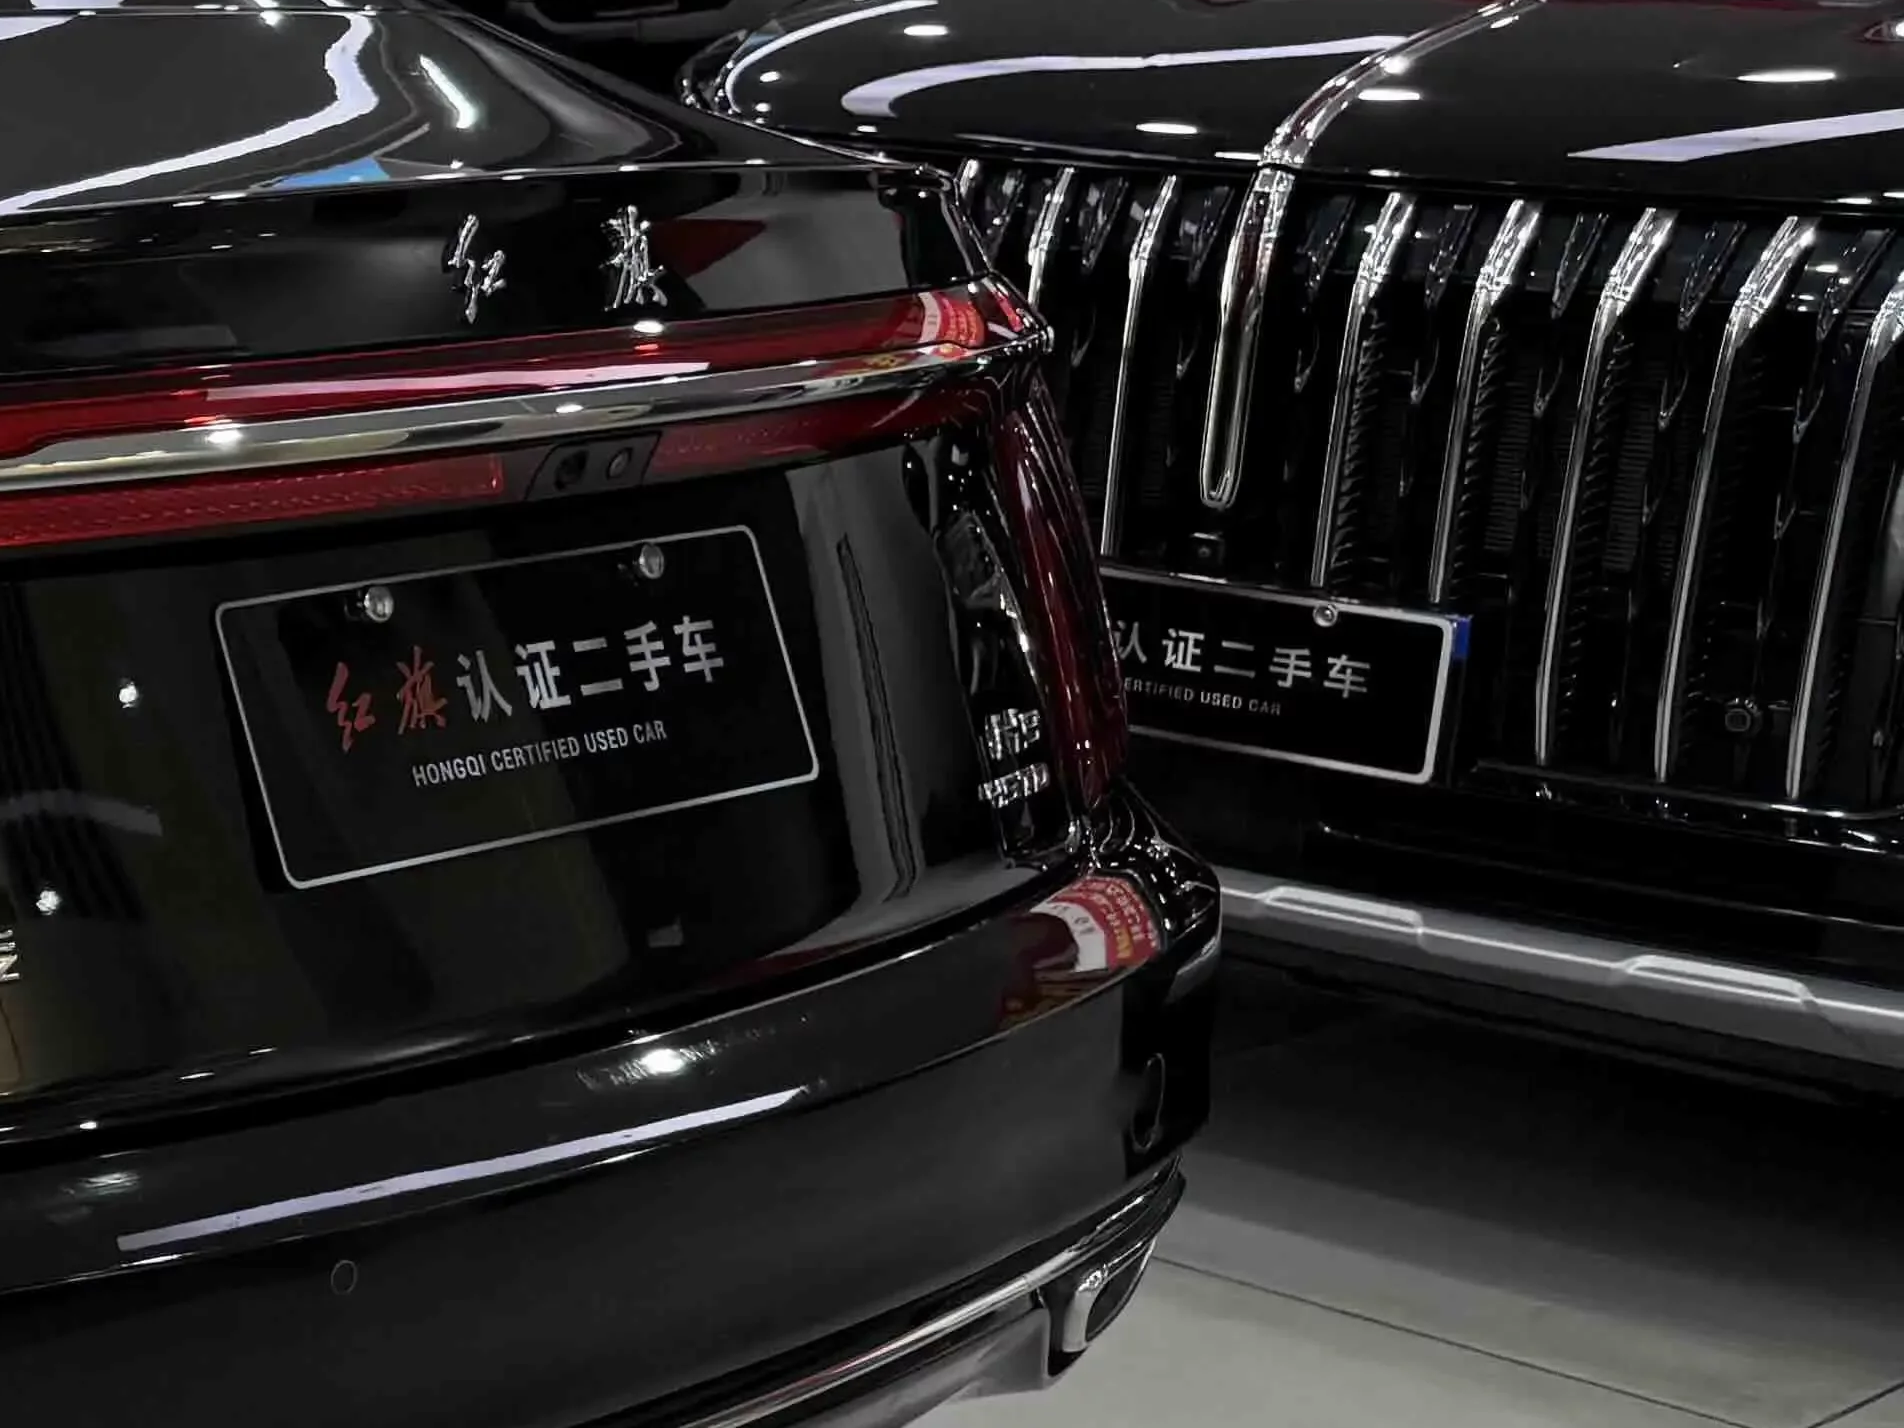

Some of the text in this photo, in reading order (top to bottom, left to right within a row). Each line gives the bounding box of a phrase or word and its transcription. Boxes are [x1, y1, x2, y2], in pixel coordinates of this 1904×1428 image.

[448, 204, 668, 323] 红旗
[1114, 620, 1371, 699] 认证二手车
[1123, 676, 1281, 716] ERTIFIED USED CAR
[412, 719, 667, 787] HONGQI CERTIFIED USED CAR
